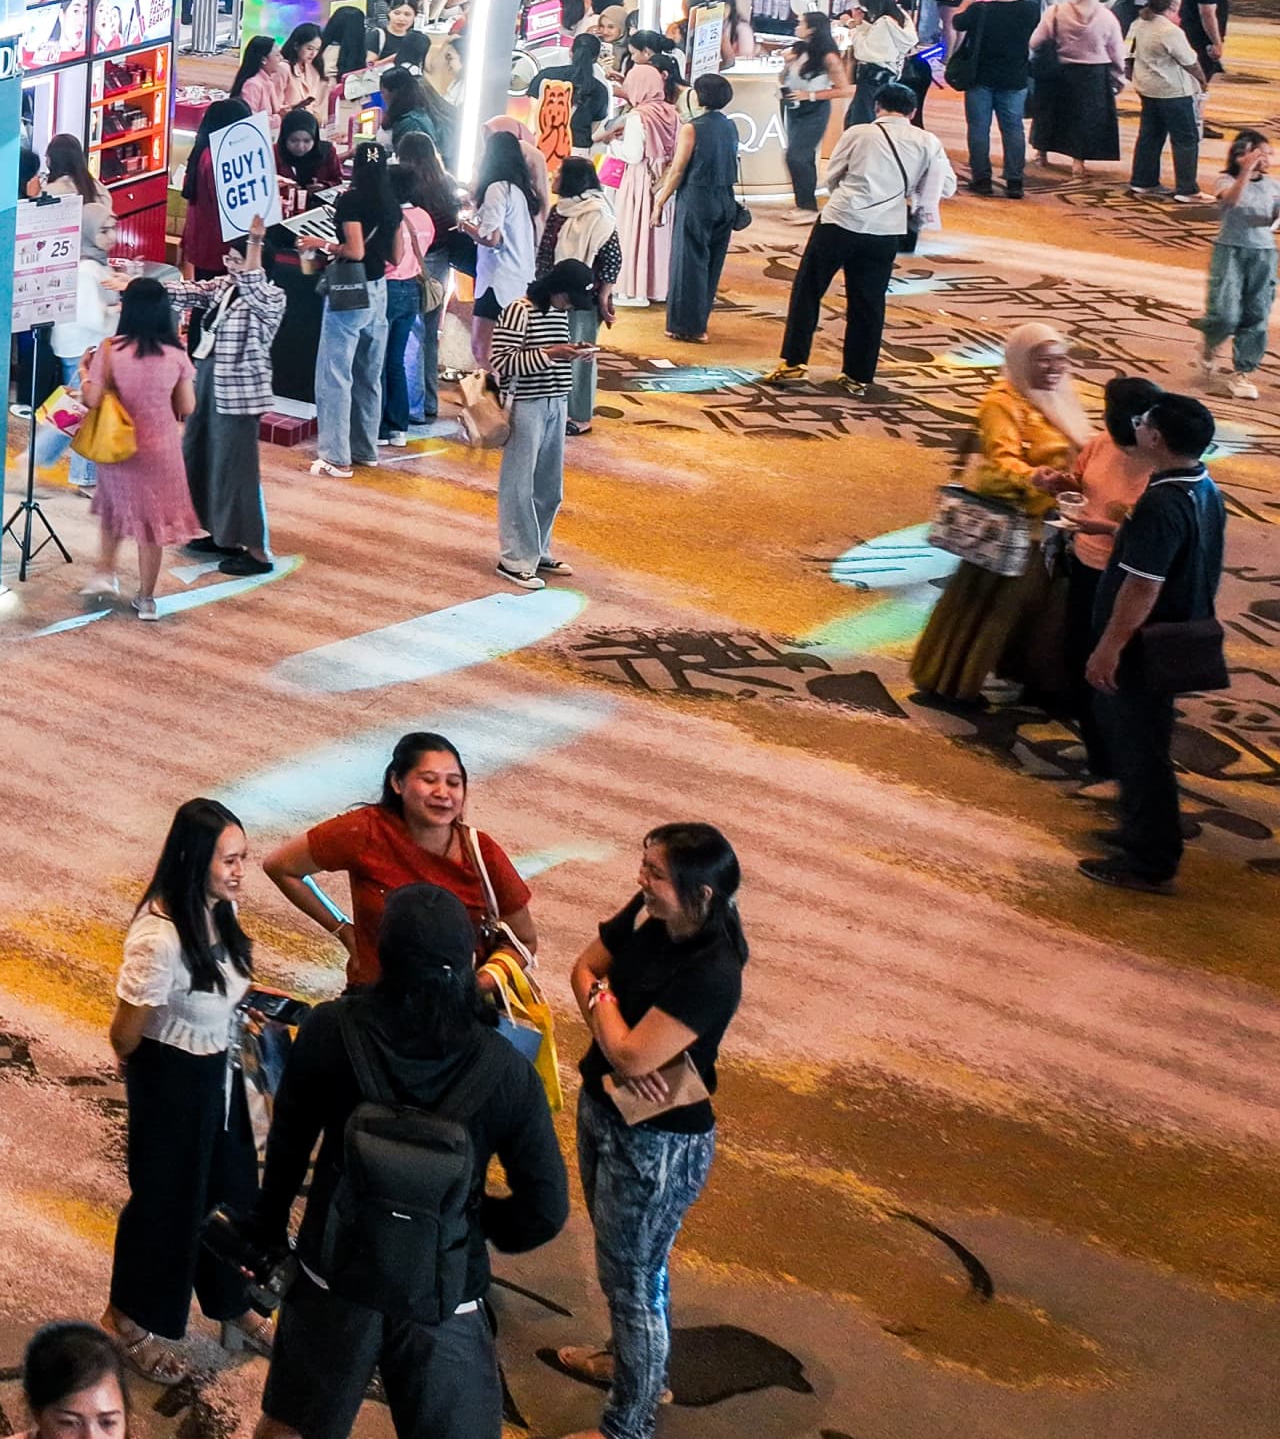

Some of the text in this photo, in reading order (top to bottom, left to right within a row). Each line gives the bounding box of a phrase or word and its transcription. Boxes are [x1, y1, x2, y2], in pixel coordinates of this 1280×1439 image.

[222, 148, 265, 184] BUY 1
[226, 175, 269, 210] GET 1
